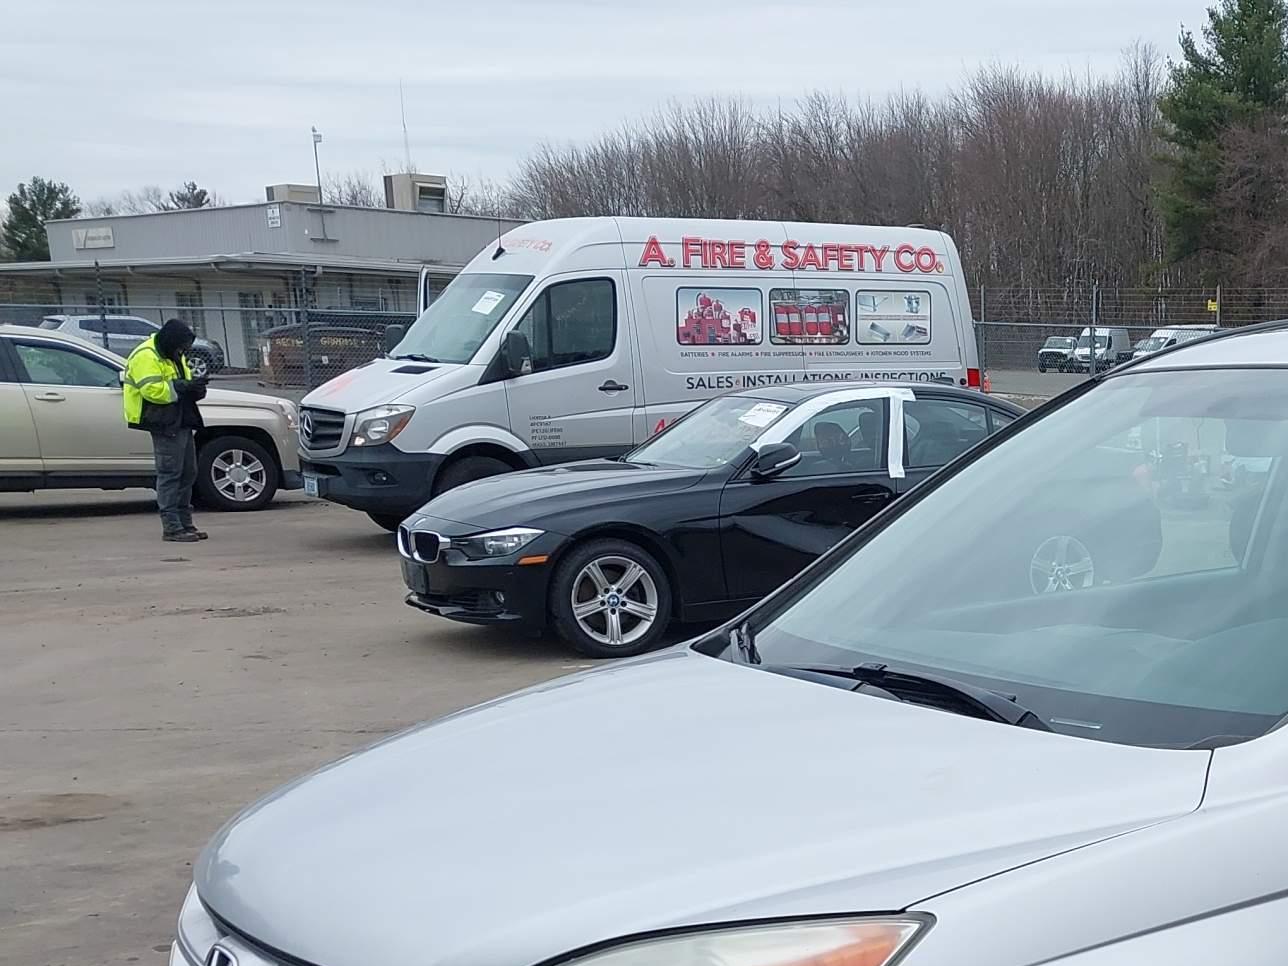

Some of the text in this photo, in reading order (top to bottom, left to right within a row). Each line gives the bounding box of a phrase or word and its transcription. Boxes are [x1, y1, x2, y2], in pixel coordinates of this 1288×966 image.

[639, 234, 944, 273] A. FIRE & SAFETY CO.
[686, 375, 734, 390] SALES
